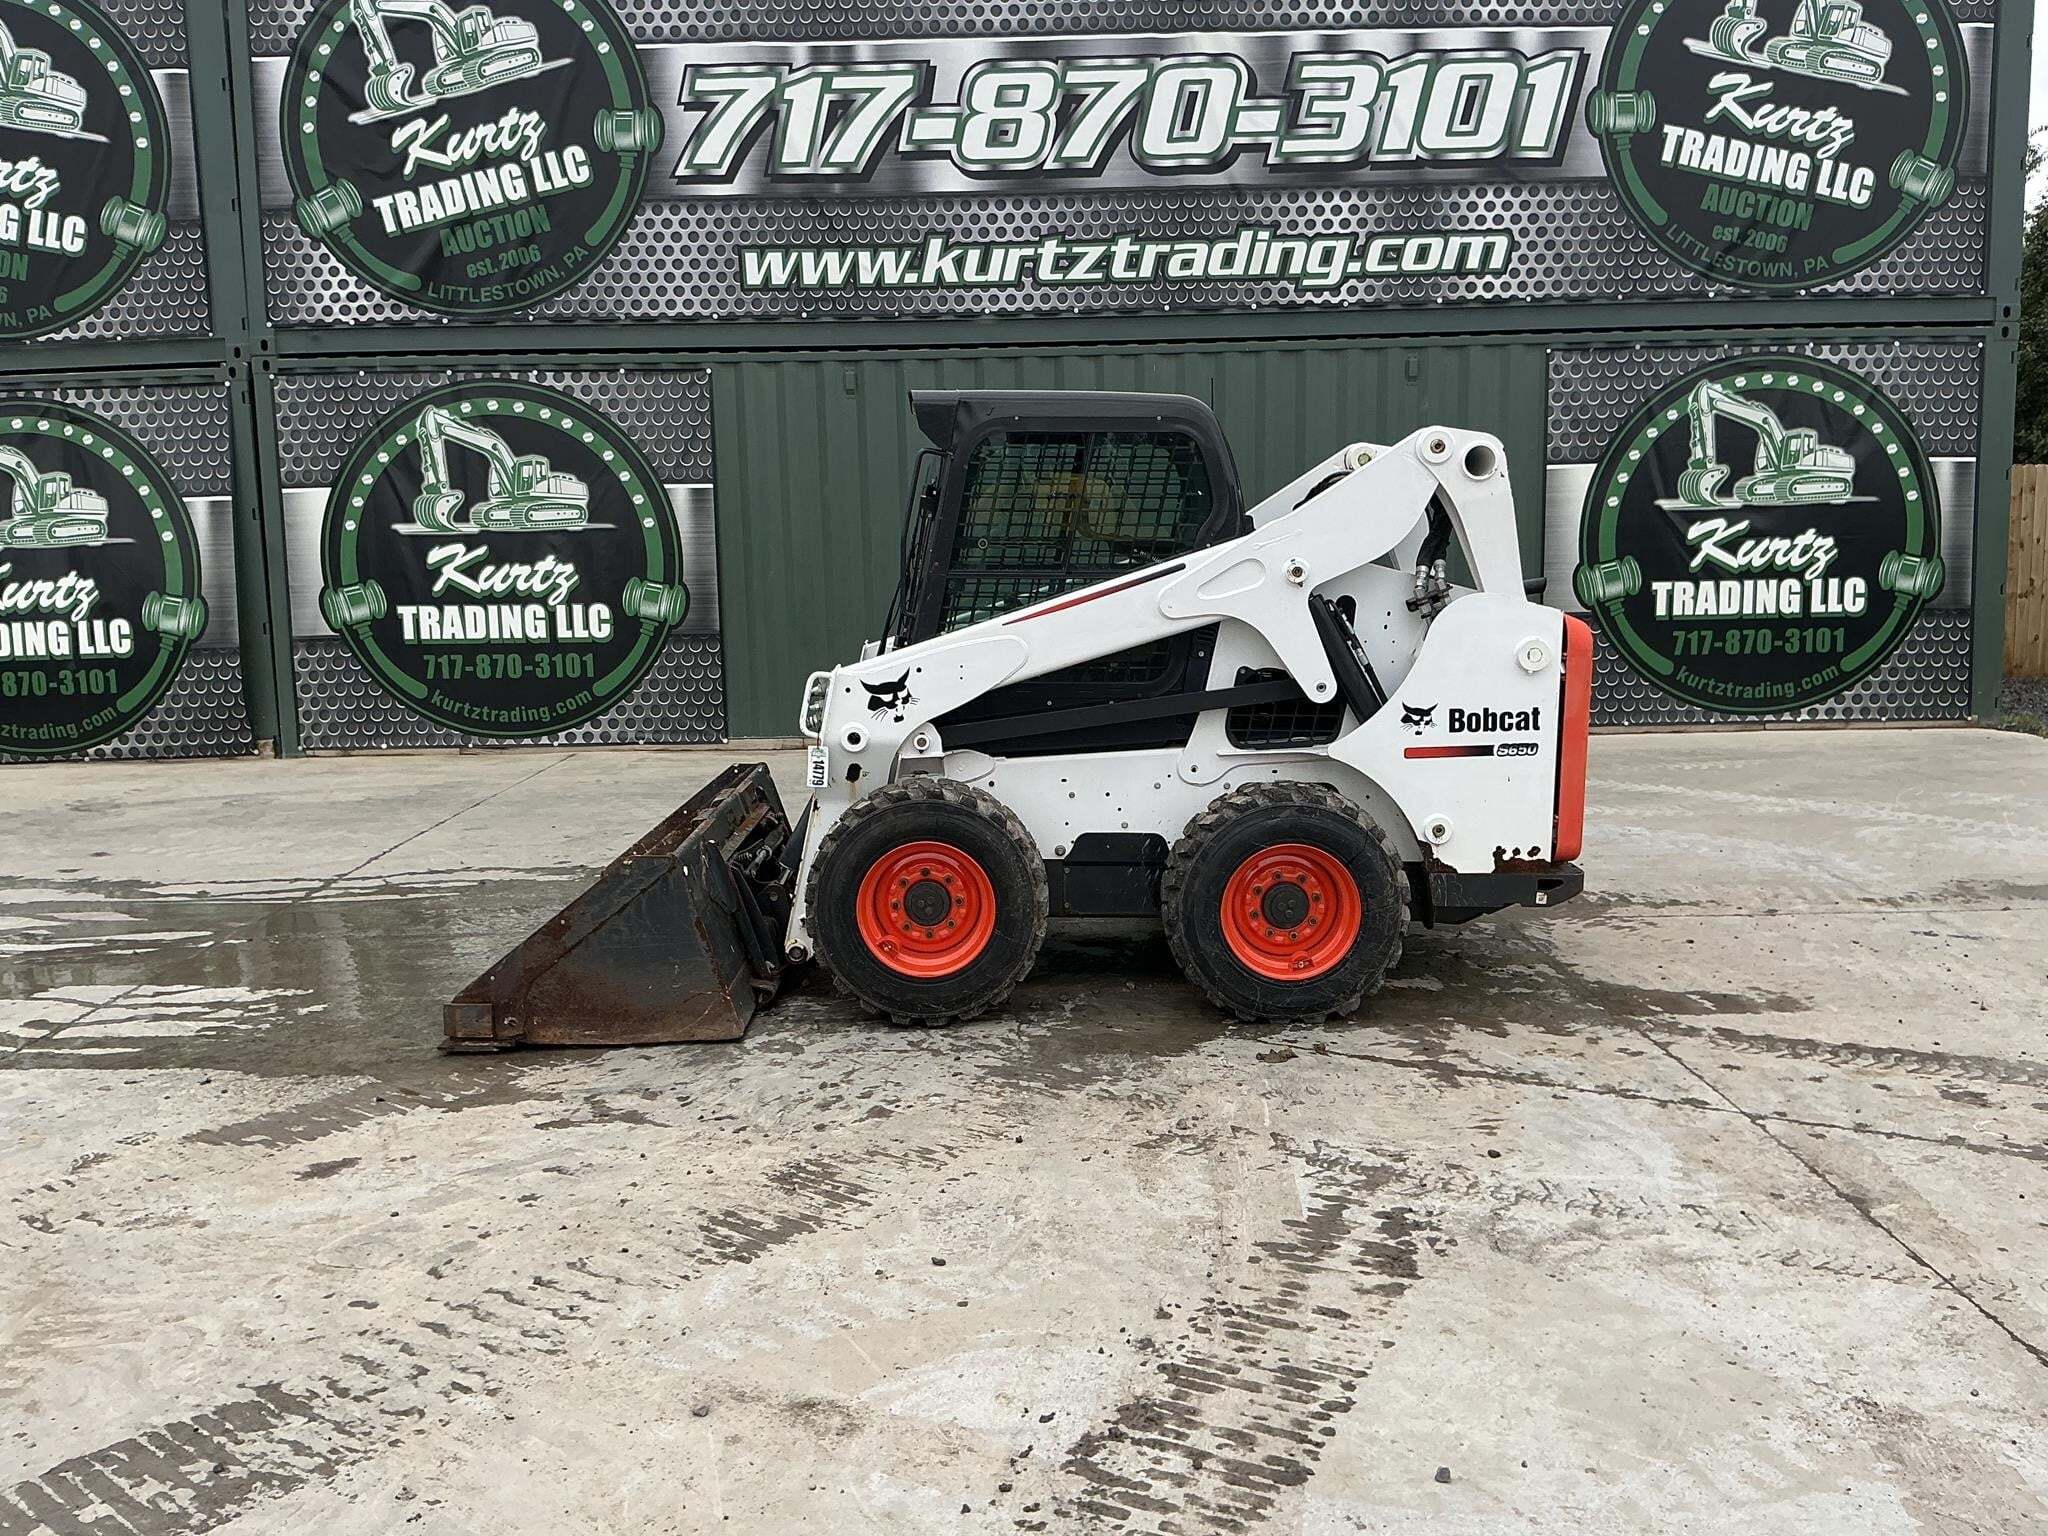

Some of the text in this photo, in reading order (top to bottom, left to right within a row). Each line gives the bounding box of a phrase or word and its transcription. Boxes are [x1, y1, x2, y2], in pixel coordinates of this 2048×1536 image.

[683, 53, 1578, 173] 717-870-3101
[1706, 72, 1854, 158] Kurtz
[393, 109, 546, 174] Kurtz
[1661, 125, 1874, 205] TRADING LLC
[374, 146, 591, 233] TRADING LLC
[1700, 184, 1814, 231] AUCTION
[28, 209, 86, 253] LLC
[441, 206, 551, 257] AUCTION
[1665, 223, 1829, 278] LITTLESTOWN, PA
[1712, 226, 1788, 253] est. 2006
[427, 246, 589, 302] LITTLESTOWN, PA
[466, 246, 541, 278] est. 2006
[743, 228, 1509, 290] www.kurtztrading.com
[26, 305, 52, 323] PA
[1687, 519, 1838, 579] Kurtz
[427, 544, 578, 605] Kurtz
[1652, 577, 1866, 616] TRADING LLC
[78, 618, 132, 655] LLC
[398, 603, 613, 641] TRADING LLC
[1672, 628, 1845, 656] 717-870-3101
[424, 653, 595, 680] 717-870-3101
[1676, 664, 1839, 699] kurtztrading.com
[431, 689, 592, 723] kurtztrading.com
[1449, 707, 1540, 733] Bobcat
[1496, 742, 1539, 757] S650
[811, 760, 825, 785] 14779
